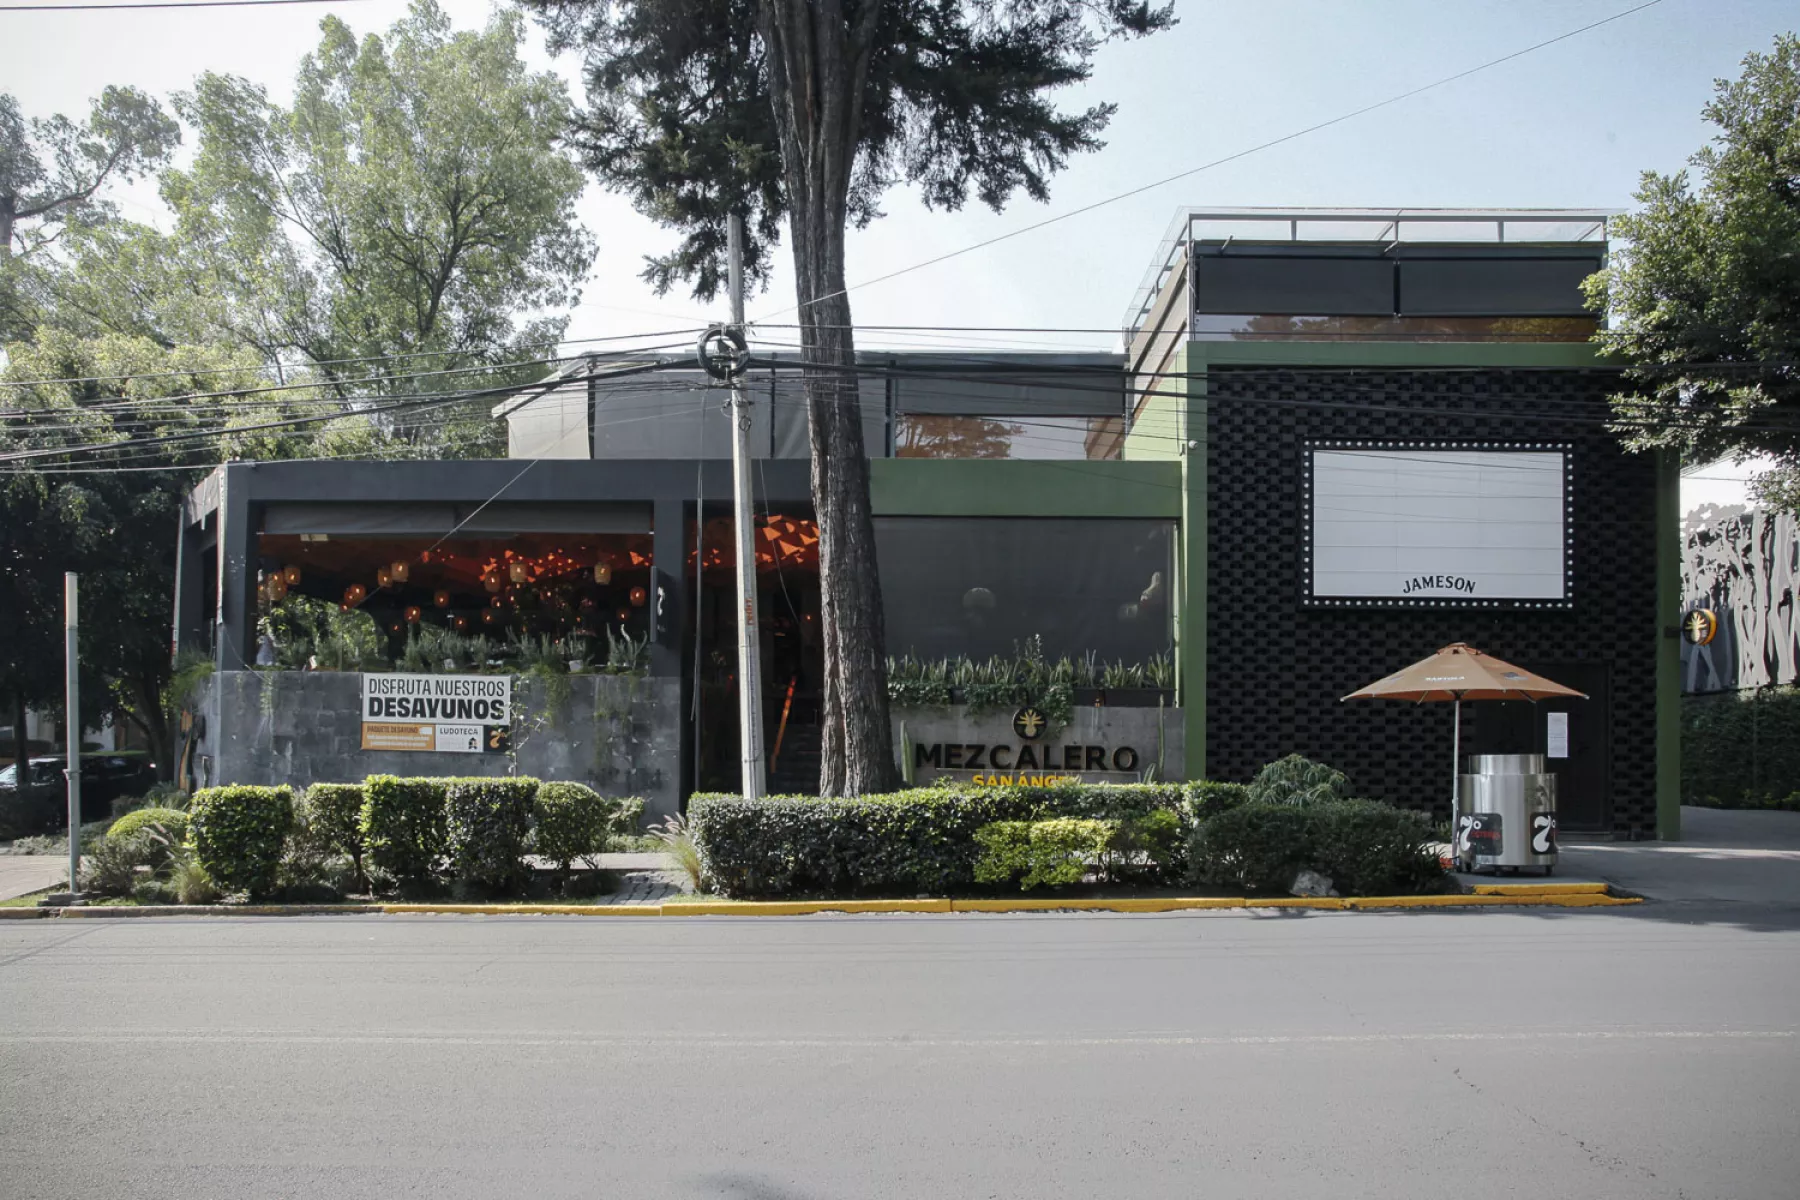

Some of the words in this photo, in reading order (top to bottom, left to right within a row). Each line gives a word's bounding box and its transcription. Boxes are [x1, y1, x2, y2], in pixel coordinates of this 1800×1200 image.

[1403, 575, 1476, 594] JAMESON
[369, 678, 431, 695] DISFRUTA
[435, 680, 505, 697] NUESTROS
[368, 697, 505, 720] DESAYUNOS
[440, 727, 478, 735] LUDOTECA
[915, 743, 1139, 771] MEZCALERO
[972, 775, 1014, 786] SAN
[1018, 771, 1064, 788] ÁNG
